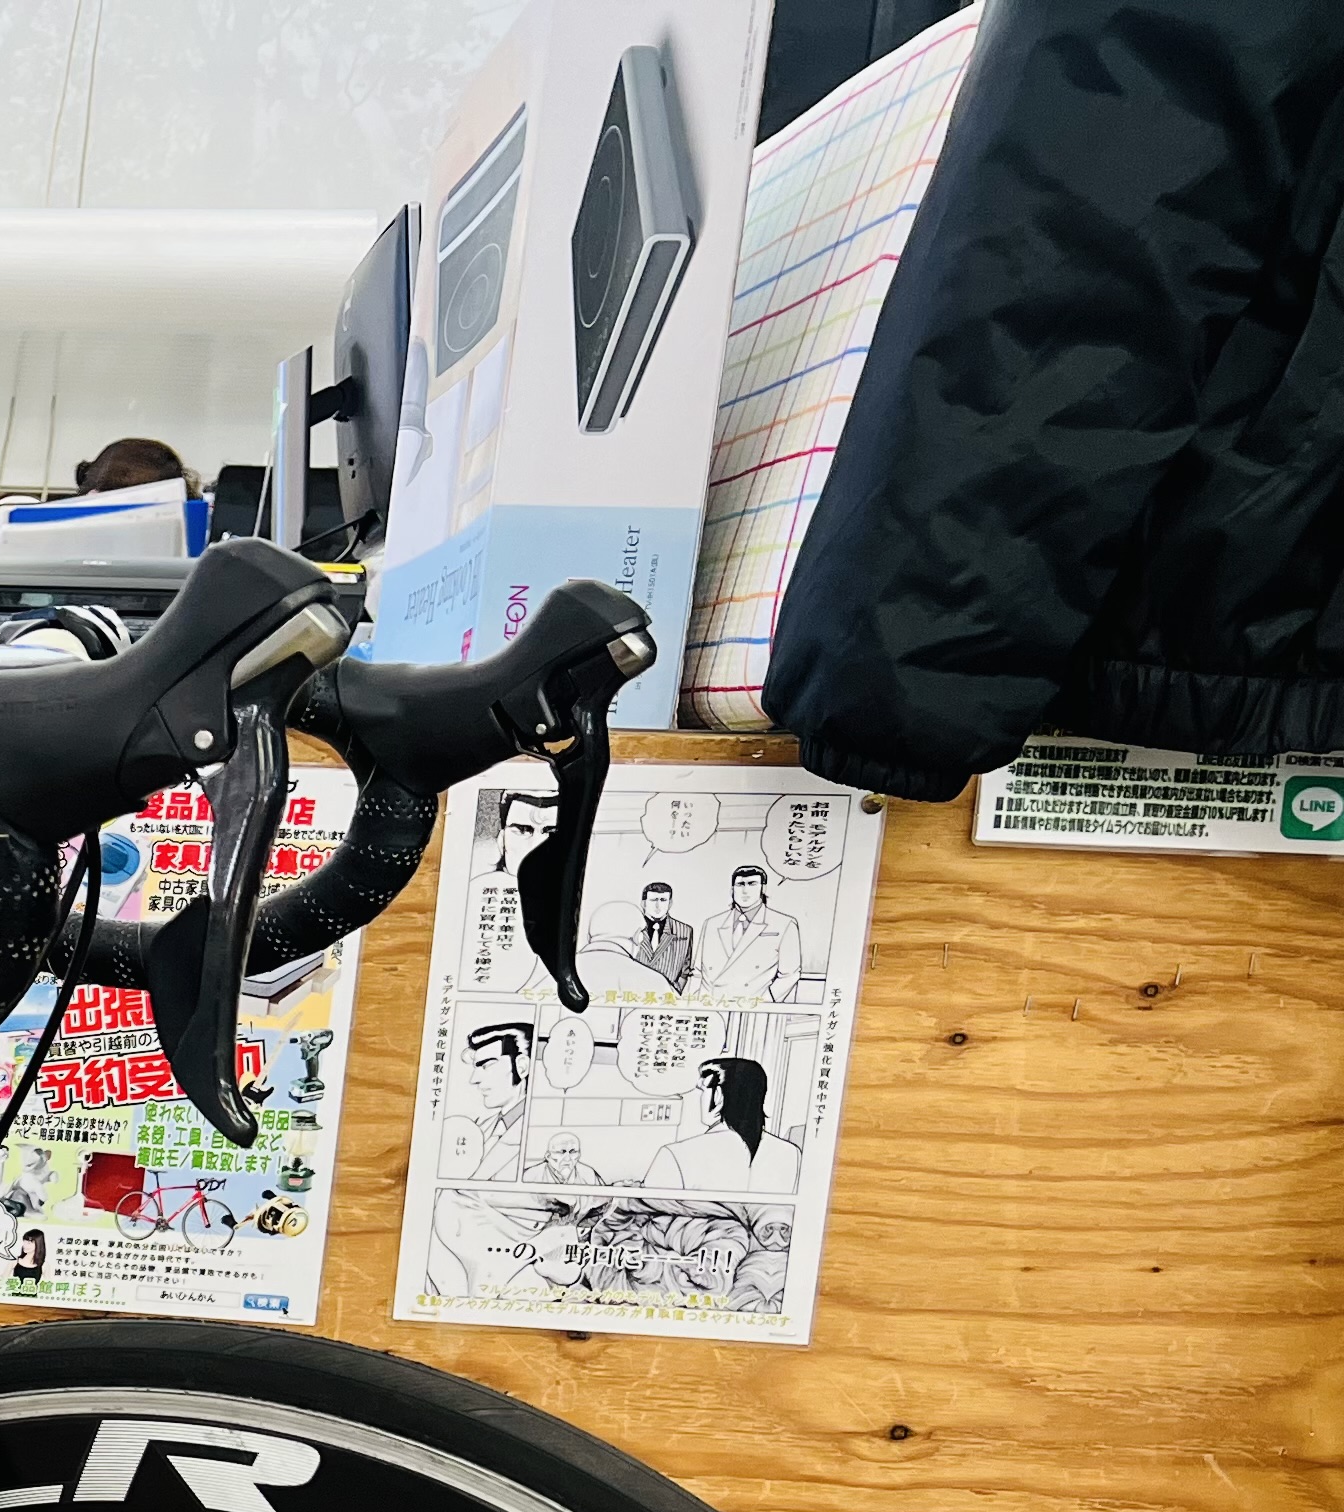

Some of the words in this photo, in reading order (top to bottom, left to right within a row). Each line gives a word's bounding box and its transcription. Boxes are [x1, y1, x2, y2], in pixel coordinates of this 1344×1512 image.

[614, 525, 640, 595] Heater
[1299, 799, 1336, 813] LINE
[520, 988, 765, 1010] モデン買取募集中なんです
[455, 1136, 467, 1158] はい
